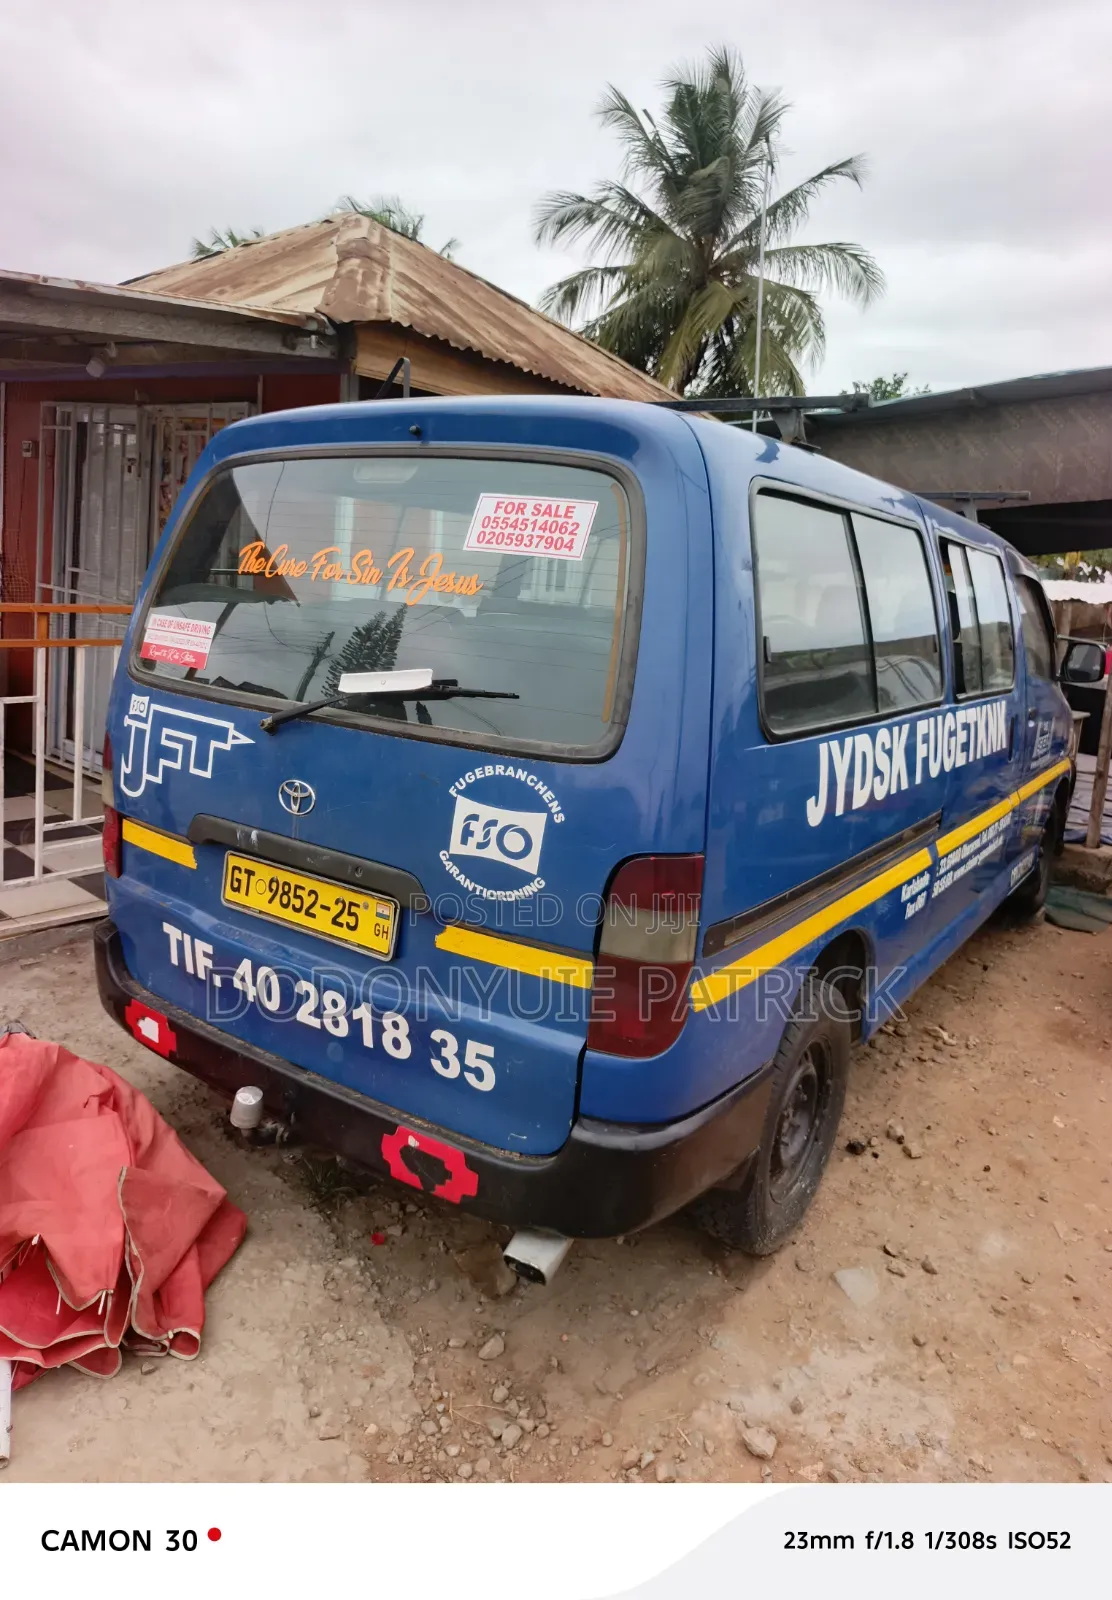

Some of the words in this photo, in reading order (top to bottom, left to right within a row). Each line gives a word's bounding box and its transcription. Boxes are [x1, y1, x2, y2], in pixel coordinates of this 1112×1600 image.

[481, 516, 580, 536] 0554514062
[493, 501, 527, 515] FOR
[531, 504, 576, 519] SALE
[476, 530, 575, 552] 0205937904
[238, 541, 267, 575] The
[264, 543, 308, 579] Cure
[311, 546, 343, 581] For
[347, 549, 383, 585] Sin
[387, 547, 414, 592] Is
[405, 553, 484, 605] Jesus
[191, 623, 211, 635] DRIVING
[449, 764, 565, 824] FUGEBRANCHENS
[806, 723, 910, 827] JYDSK
[460, 814, 533, 860] FSO
[229, 864, 255, 893] GT
[267, 876, 360, 932] 9852-25
[439, 850, 546, 902] GARANTIORDNING
[373, 922, 390, 941] GH
[233, 958, 280, 1012] 40
[295, 980, 411, 1060] 2818
[430, 1029, 496, 1092] 35
